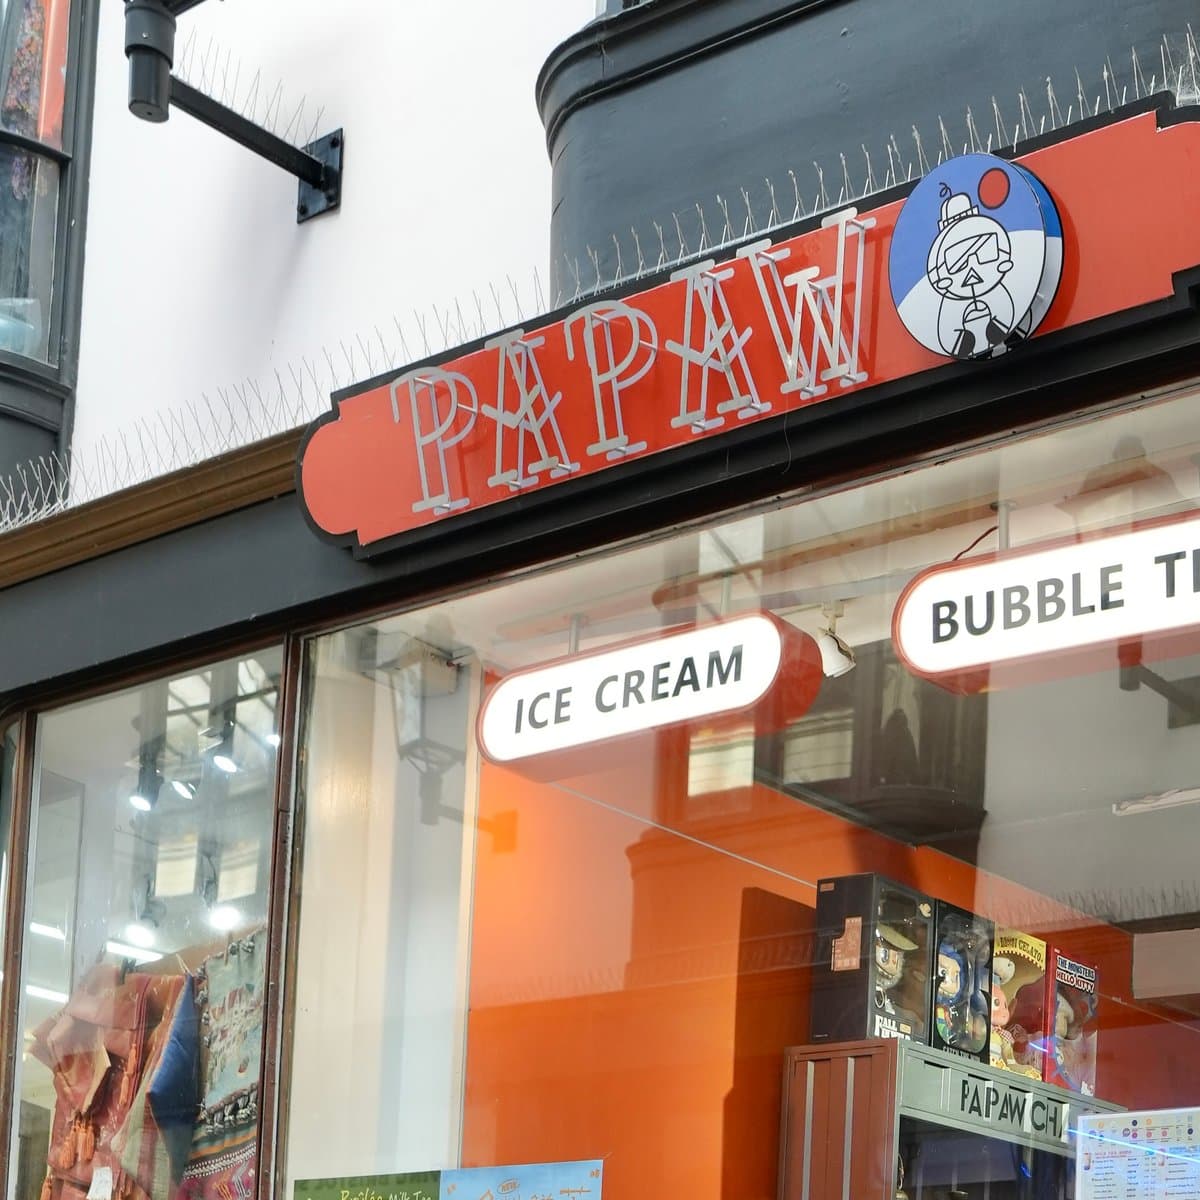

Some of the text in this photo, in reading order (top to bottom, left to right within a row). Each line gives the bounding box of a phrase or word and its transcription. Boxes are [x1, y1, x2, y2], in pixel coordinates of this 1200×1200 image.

[390, 207, 877, 515] PAPAW
[931, 561, 1125, 645] BUBBLE
[514, 643, 745, 734] ICE CREAM
[1056, 970, 1076, 985] HELLO
